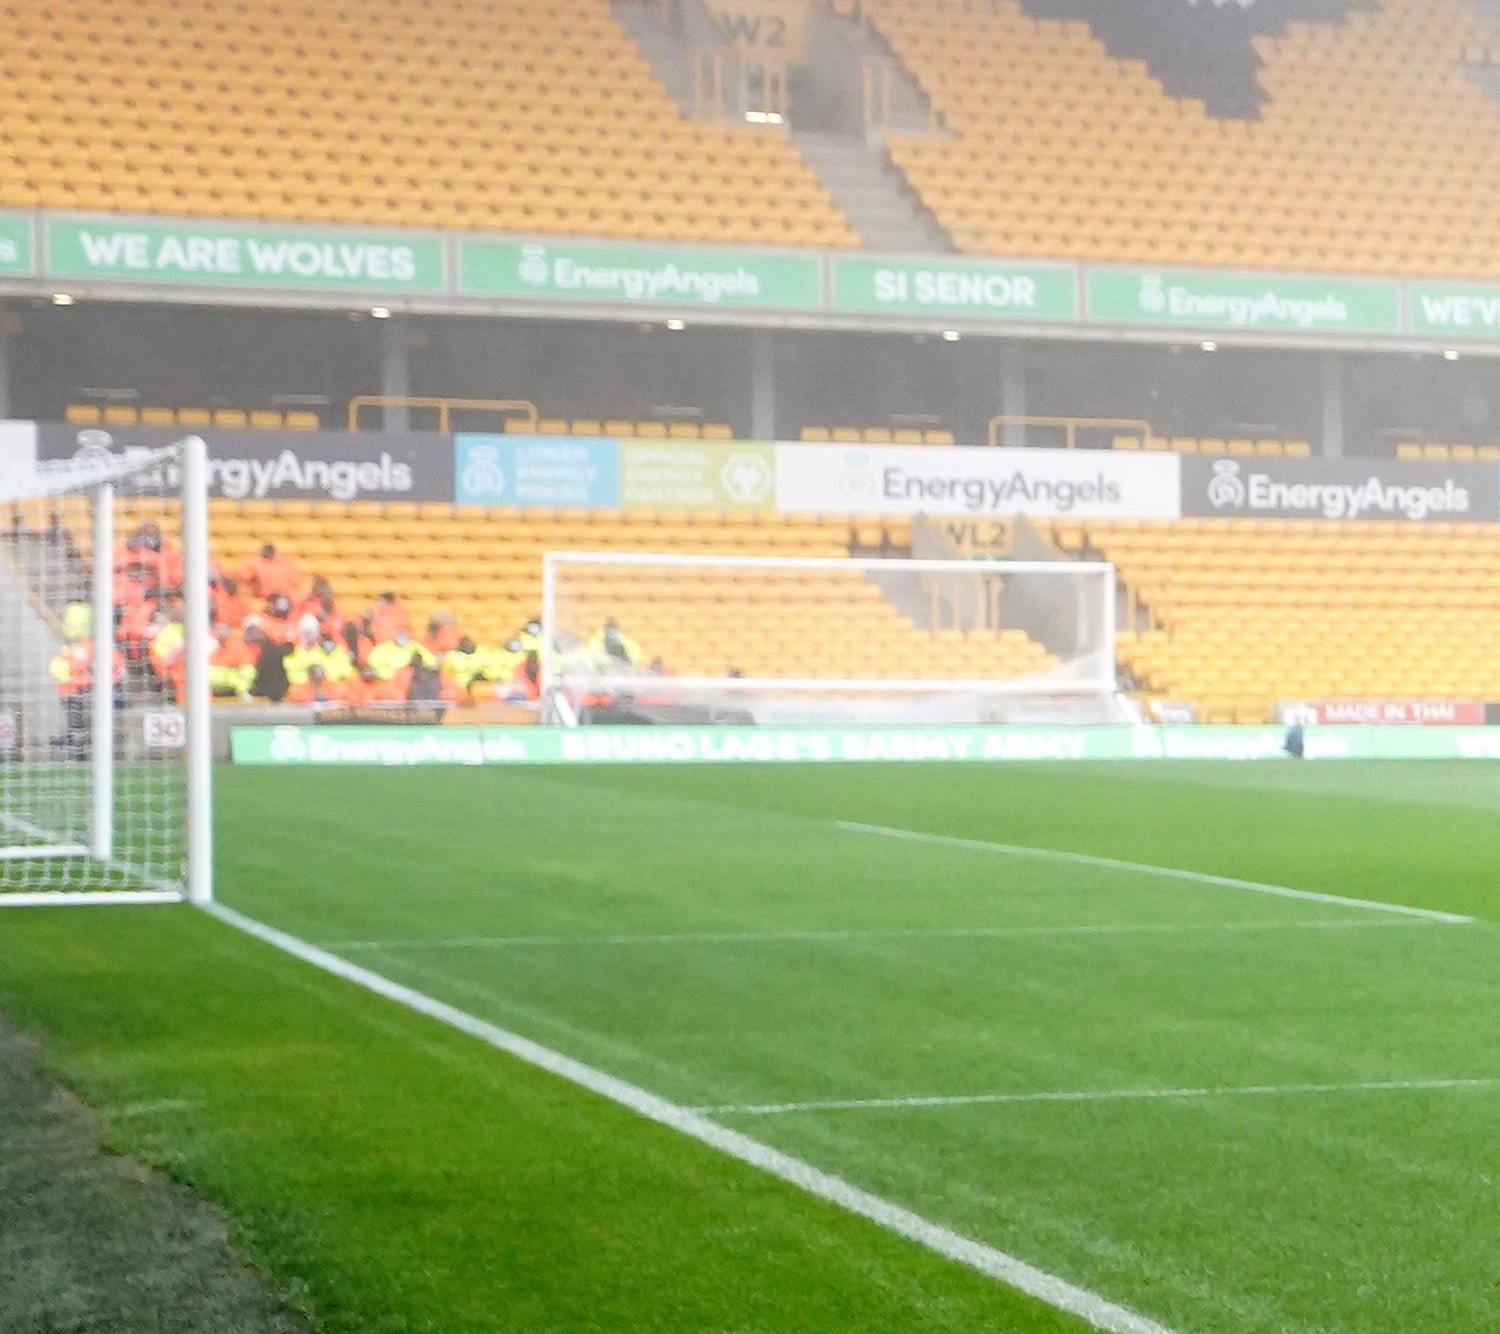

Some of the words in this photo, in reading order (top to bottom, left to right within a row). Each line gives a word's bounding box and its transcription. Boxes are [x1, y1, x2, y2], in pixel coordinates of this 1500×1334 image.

[79, 231, 149, 267] WE
[157, 235, 241, 273] ARE
[246, 238, 416, 281] WOLVES
[554, 257, 759, 302] EnergyAngels
[873, 269, 907, 301] SI
[914, 272, 1035, 308] SENOR
[1168, 286, 1347, 326] EnergyAngels
[882, 467, 1121, 511] EnergyAngels
[1248, 473, 1470, 520] EnergyAngels
[1325, 703, 1379, 722] MADE
[1384, 703, 1406, 722] IN
[308, 731, 526, 765] EnergyAngels
[561, 734, 697, 761] BRUNO
[699, 733, 832, 760] LAGE'S
[841, 733, 972, 760] BARMY
[982, 734, 1088, 760] ARMY
